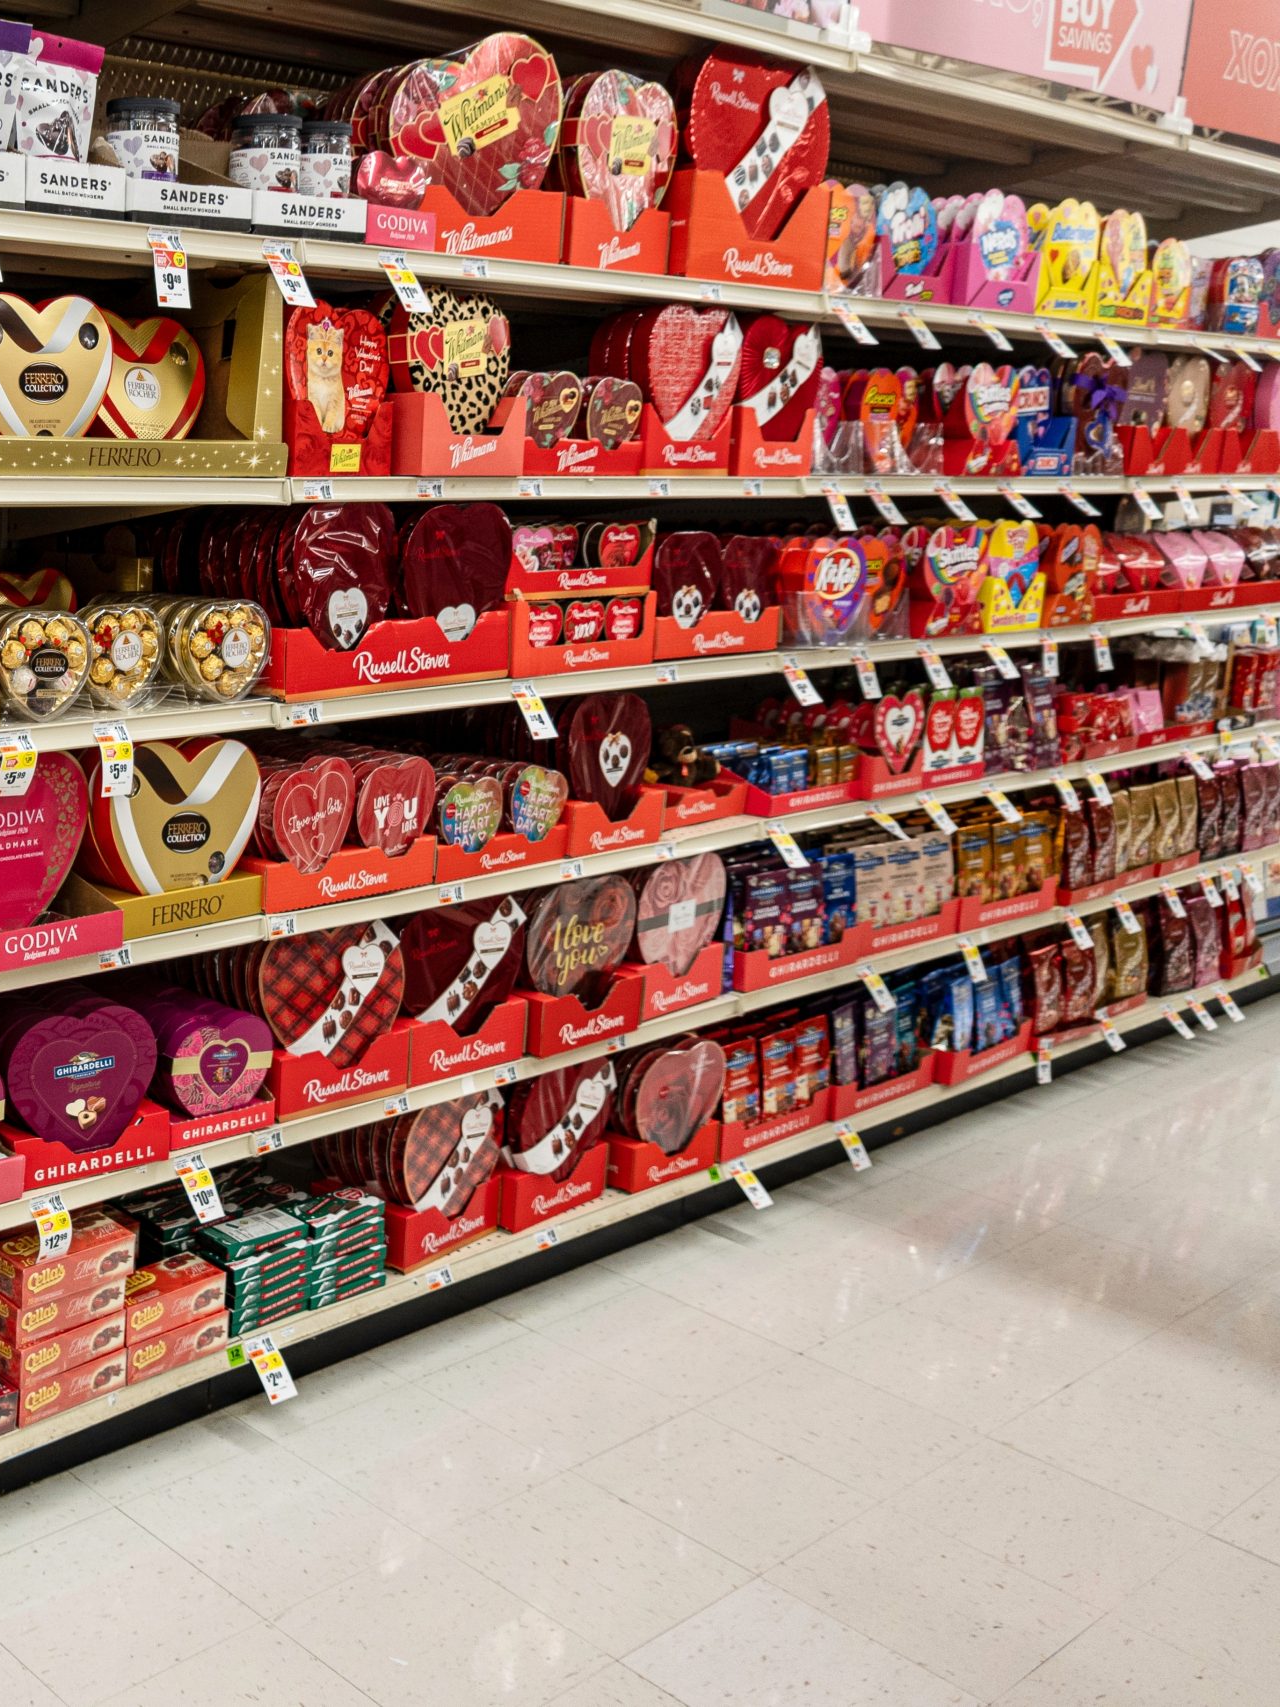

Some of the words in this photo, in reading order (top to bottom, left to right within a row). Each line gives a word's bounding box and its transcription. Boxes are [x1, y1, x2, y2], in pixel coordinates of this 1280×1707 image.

[1058, 25, 1112, 54] SAVINGS
[40, 173, 108, 191] SANDERS
[161, 189, 225, 206] SANDERS
[281, 203, 342, 220] SANDERS
[376, 212, 428, 235] GODIVA
[722, 248, 760, 278] Russell
[359, 335, 377, 349] Happy
[24, 383, 64, 393] COLLECTION
[25, 373, 64, 384] FERRERO
[89, 448, 161, 467] FERRERO
[574, 622, 595, 640] XOXO
[353, 651, 410, 683] Russell
[407, 646, 450, 672] Stover
[373, 795, 391, 809] LOVE
[455, 801, 492, 821] HAPPY
[401, 818, 418, 834] LOTS
[453, 815, 490, 834] HEART
[318, 875, 359, 897] Russell
[356, 870, 388, 889] Stover
[4, 925, 78, 954] GODIVA
[560, 914, 604, 945] love
[429, 1045, 471, 1070] Russell
[467, 1039, 506, 1058] Stover
[56, 1057, 113, 1077] GHIRARDELLI
[303, 1074, 348, 1103] Russell
[343, 1069, 390, 1089] Stover
[182, 1112, 266, 1140] GHIRARDELLI
[34, 1146, 152, 1181] GHIRARDELLI
[28, 1266, 67, 1295] Cella's
